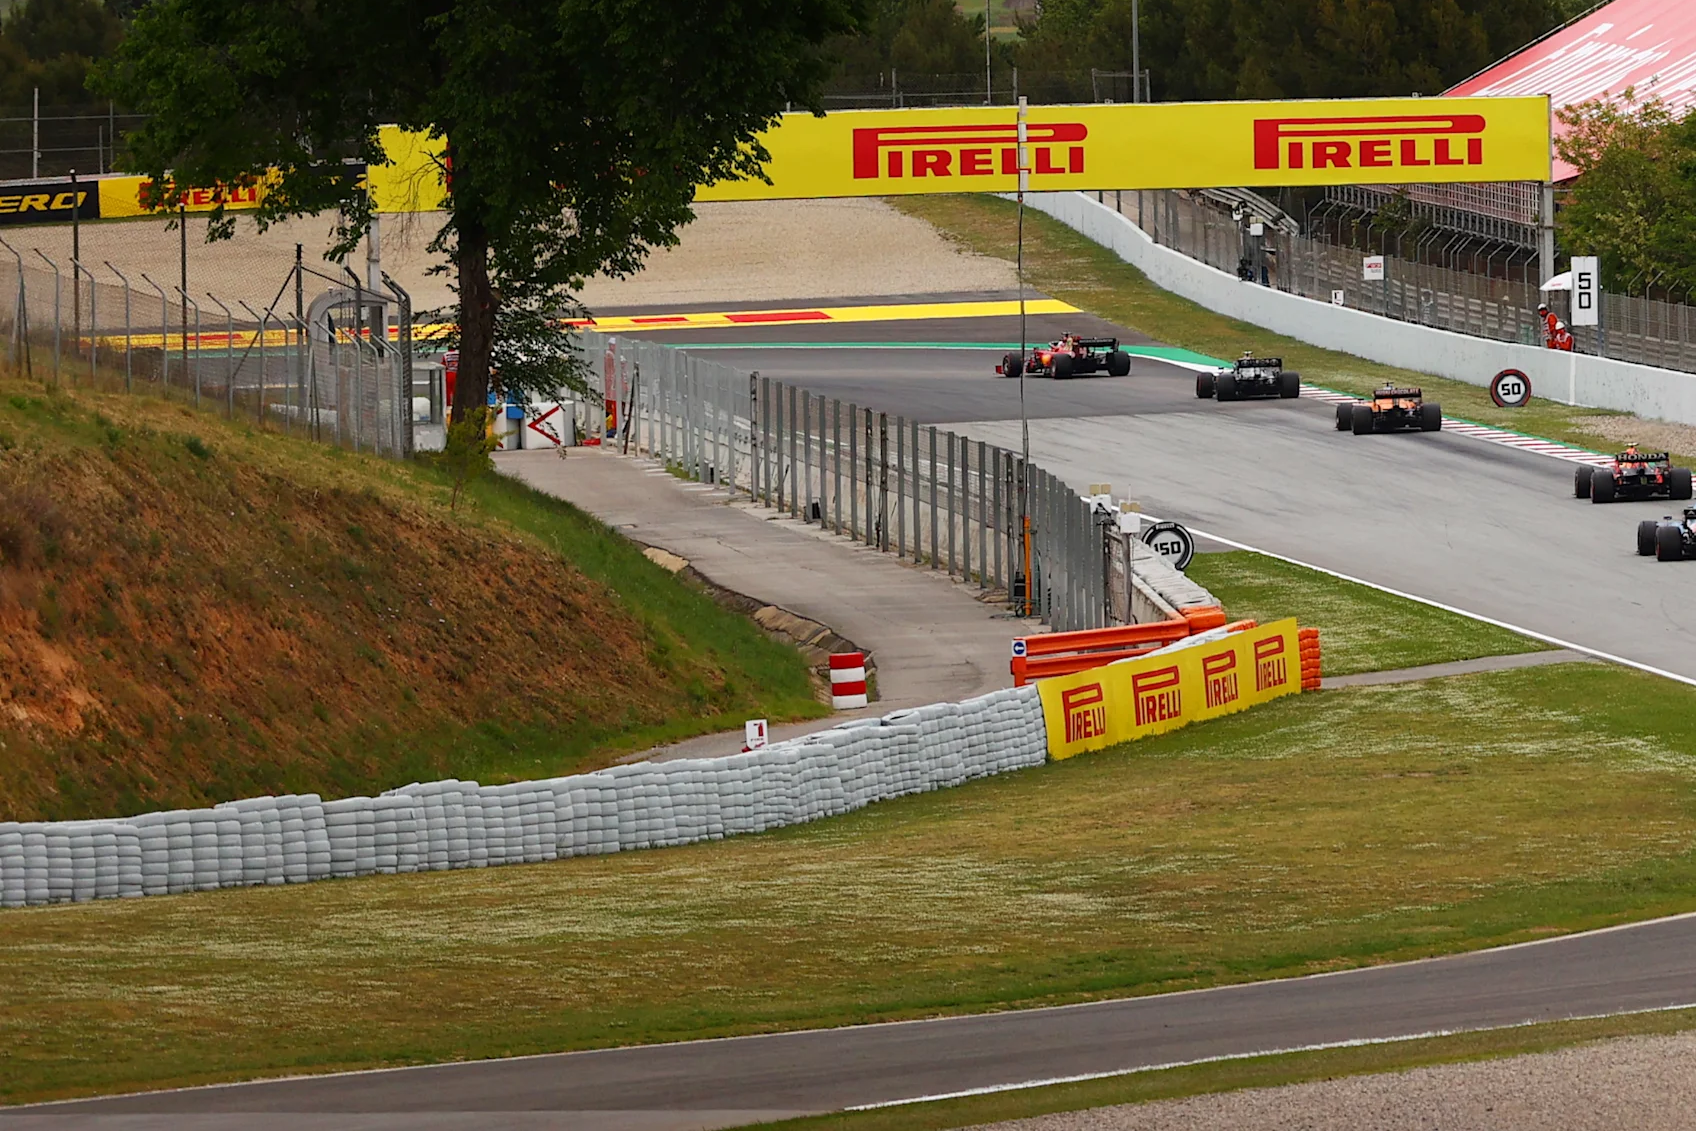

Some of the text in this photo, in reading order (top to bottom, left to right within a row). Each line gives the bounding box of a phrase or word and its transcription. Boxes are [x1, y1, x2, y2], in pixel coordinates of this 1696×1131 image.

[852, 122, 1088, 179] PIRELLI
[1253, 113, 1486, 170] PIRELLI
[1578, 272, 1592, 309] 50
[1501, 382, 1521, 396] 50
[1618, 453, 1667, 461] HONDA
[1202, 649, 1239, 709] PIRELLI
[1254, 634, 1287, 692] PIRELLI
[1062, 682, 1106, 744] PIRELLI
[1131, 665, 1182, 727] PIRELLI
